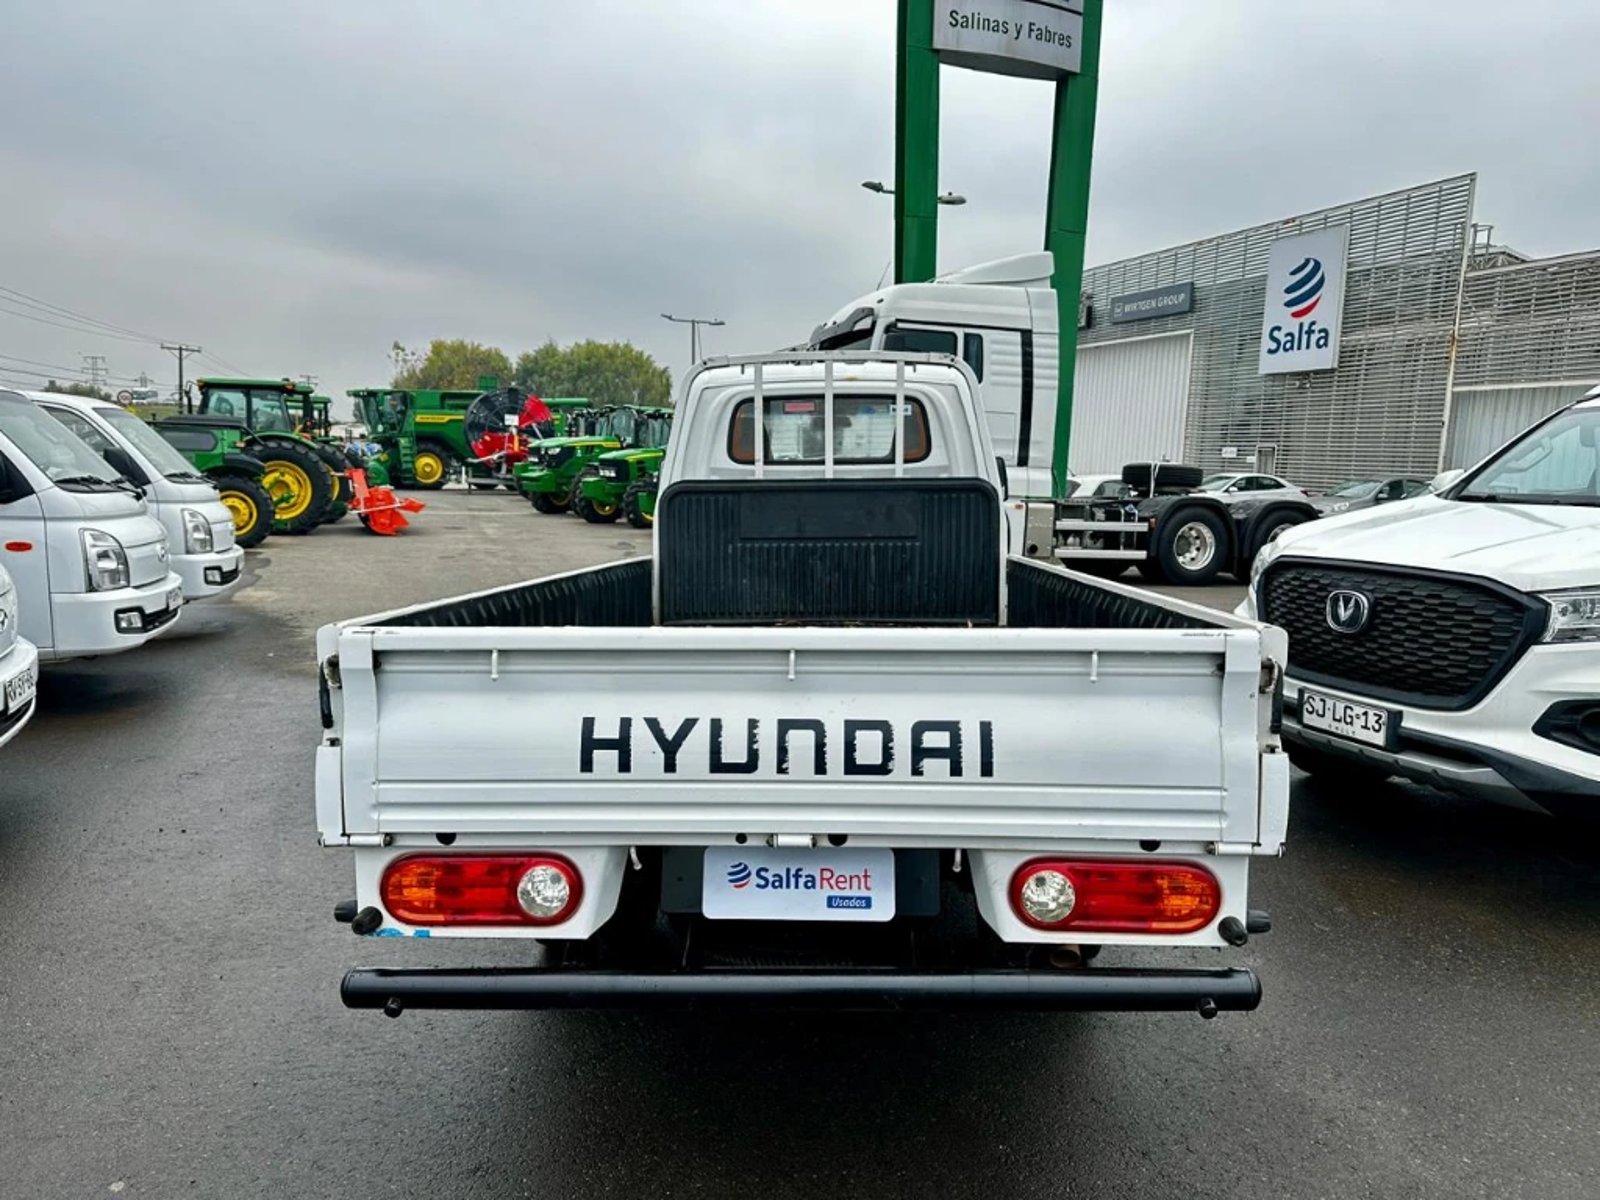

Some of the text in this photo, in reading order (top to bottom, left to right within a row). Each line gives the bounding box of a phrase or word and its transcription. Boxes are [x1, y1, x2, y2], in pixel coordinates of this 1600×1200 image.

[949, 10, 1072, 48] Salinas y Fabres
[1157, 293, 1186, 307] GROUP
[1266, 320, 1329, 355] Salfa
[579, 717, 994, 777] HYUNDAI
[755, 867, 872, 891] SalfaRent
[832, 897, 866, 908] Usados
